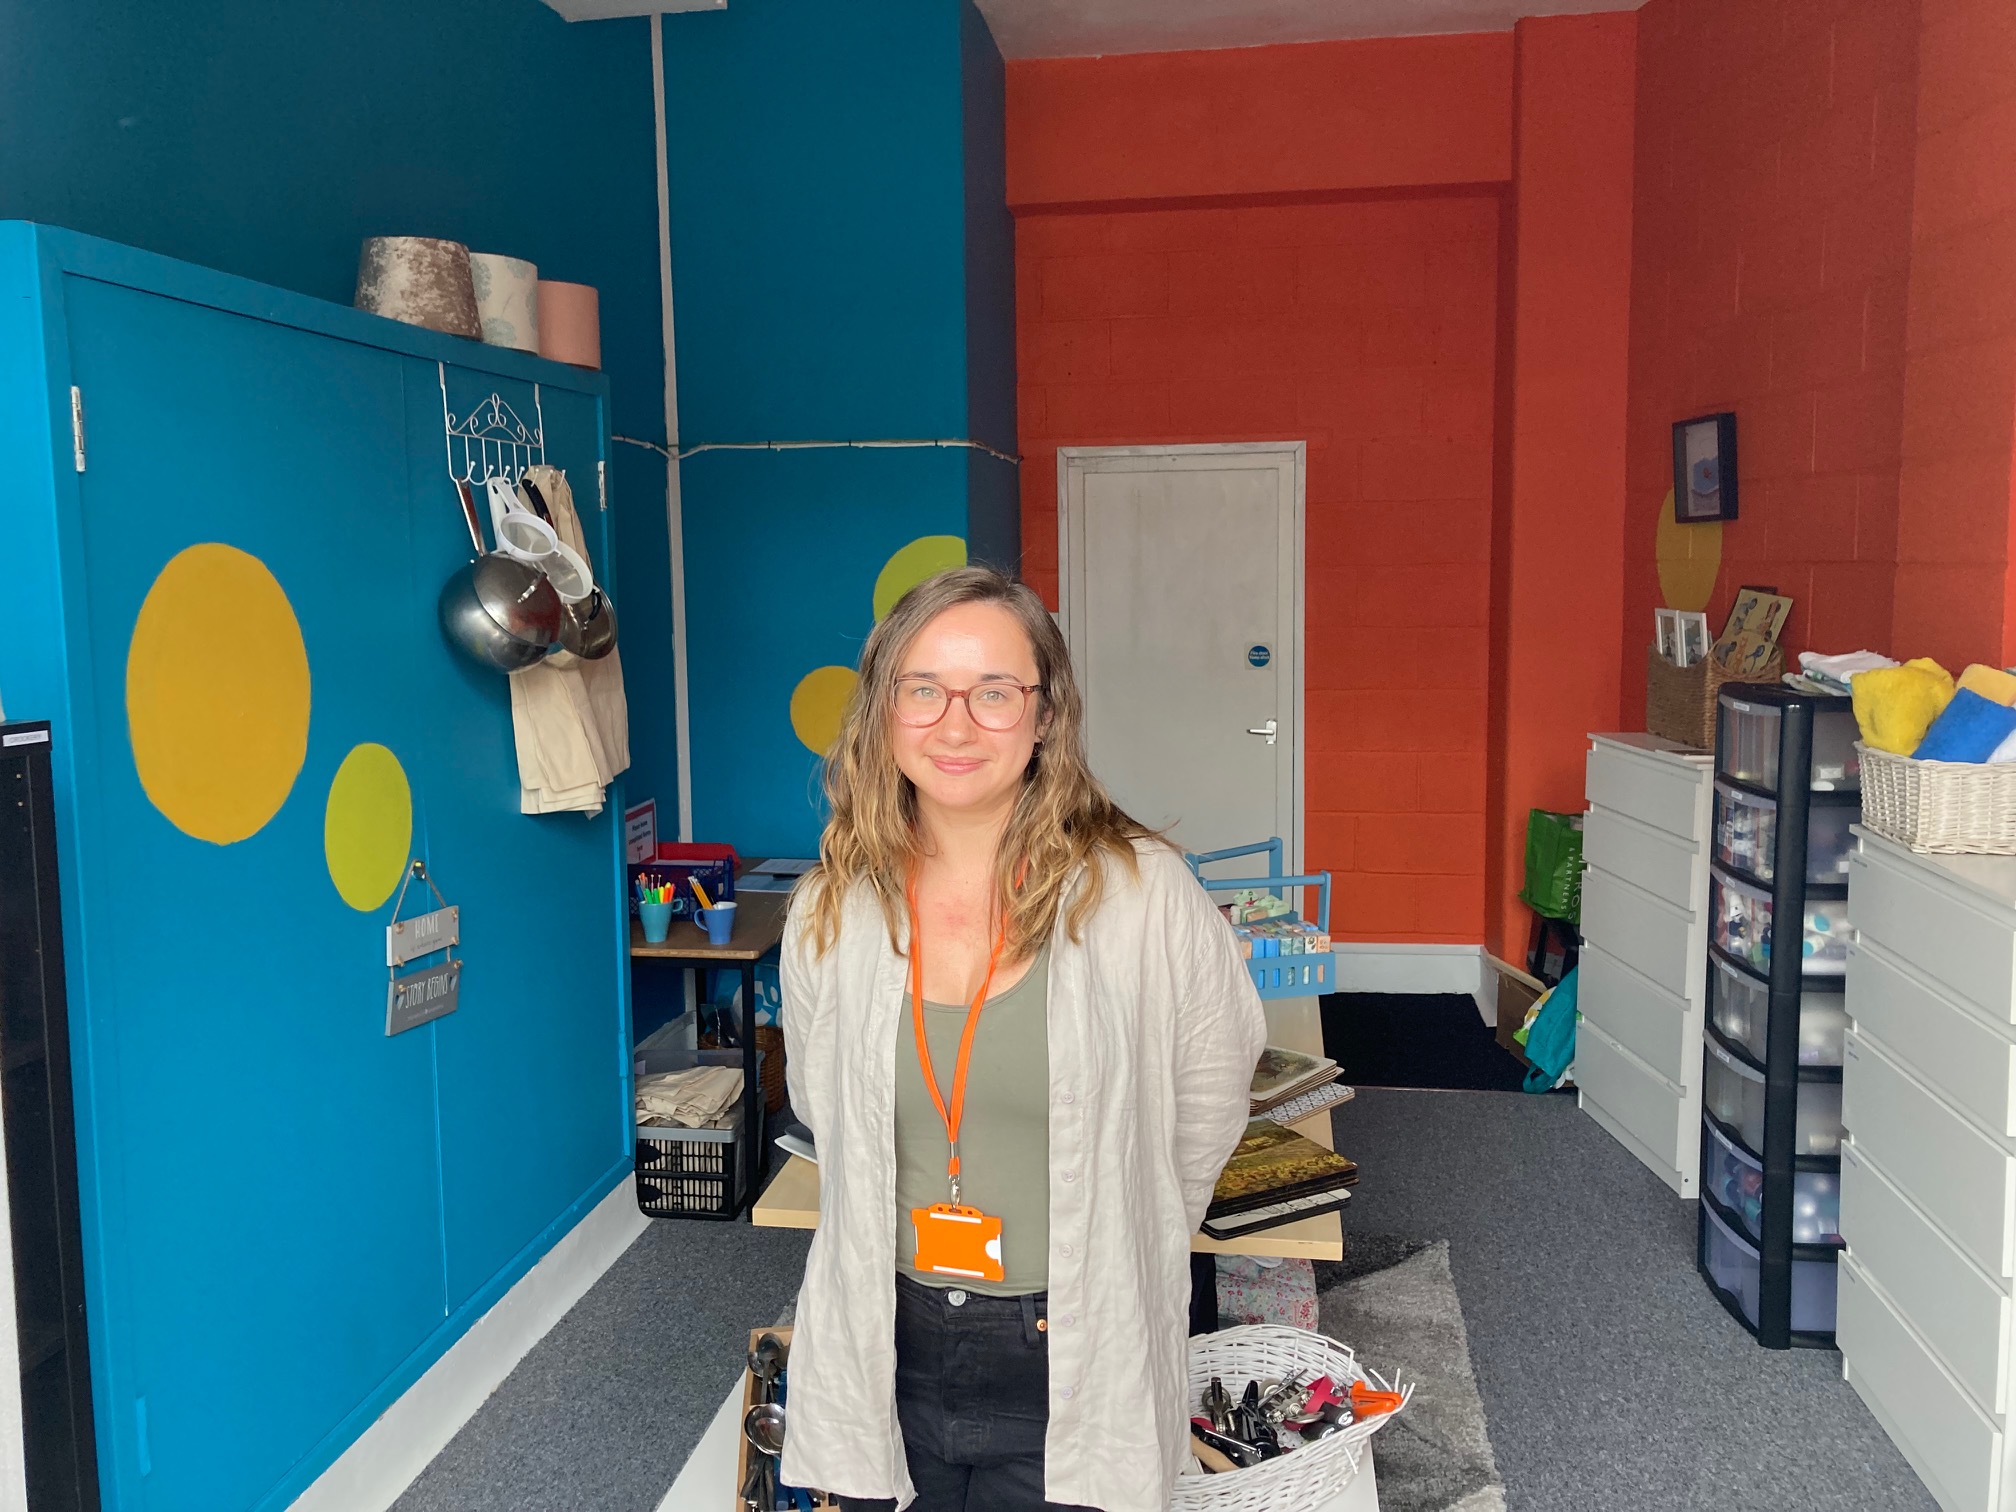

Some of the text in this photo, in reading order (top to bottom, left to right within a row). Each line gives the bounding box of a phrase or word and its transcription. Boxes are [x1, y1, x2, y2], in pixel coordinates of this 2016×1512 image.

[1560, 856, 1574, 910] PARTNERS
[415, 913, 439, 939] HOME
[405, 972, 449, 1009] STORY BEGINS
